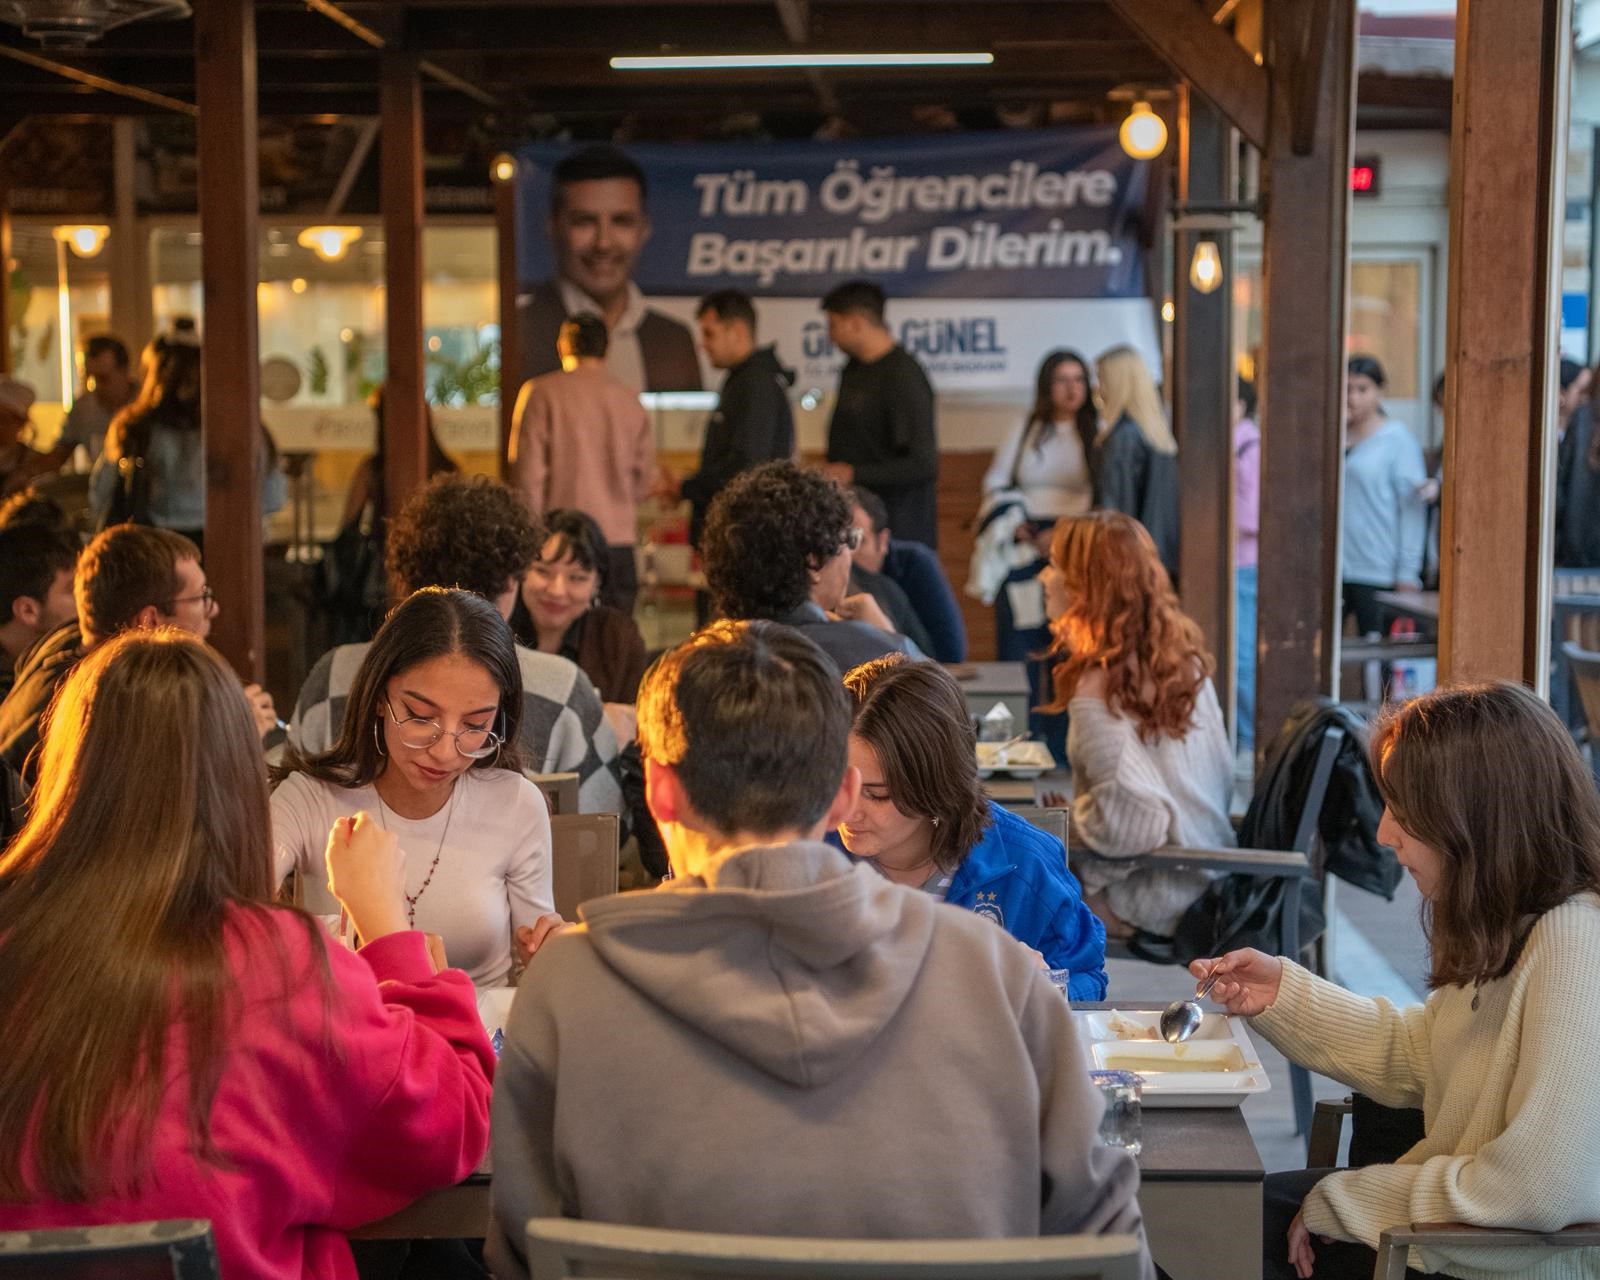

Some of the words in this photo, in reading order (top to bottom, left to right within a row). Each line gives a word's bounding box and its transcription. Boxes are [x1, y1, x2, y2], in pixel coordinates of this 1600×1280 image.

[693, 170, 808, 217] Tüm
[819, 159, 1117, 223] Öğrencilere
[926, 218, 1123, 271] Dilerim.
[901, 316, 1006, 355] GÜNEL
